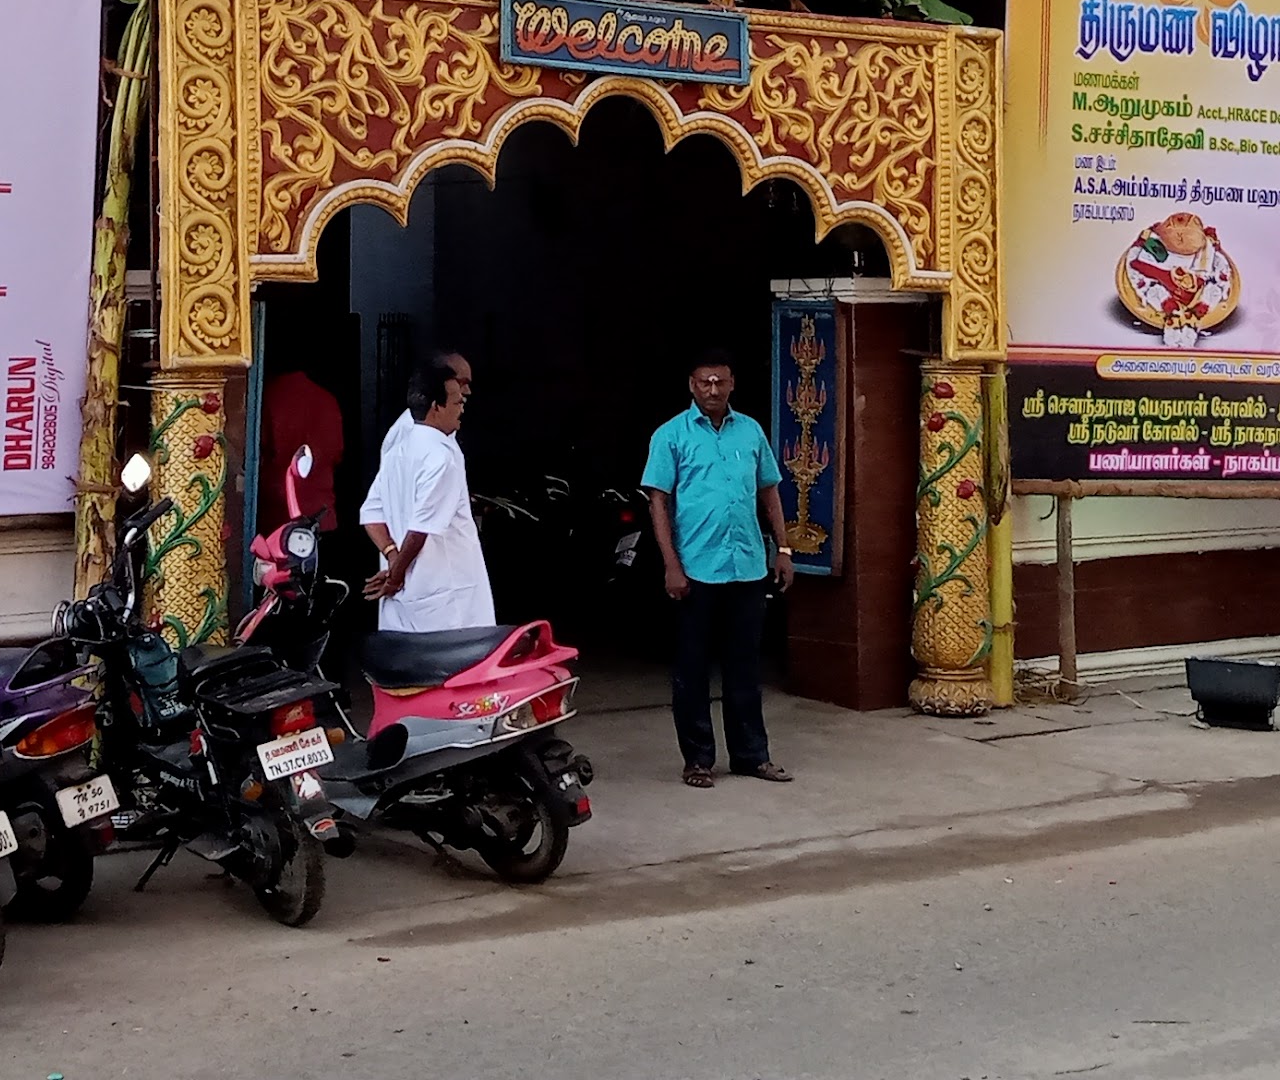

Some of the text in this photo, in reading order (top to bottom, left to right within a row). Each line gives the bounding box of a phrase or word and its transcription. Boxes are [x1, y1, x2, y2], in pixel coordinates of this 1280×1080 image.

[1074, 69, 1139, 90] மணமக்கள்
[1072, 91, 1193, 121] M.ஆறுமுகம்
[1190, 181, 1243, 204] திருமண
[3, 357, 37, 471] DHARUN
[1138, 393, 1209, 420] பெருமாள்
[1211, 395, 1267, 419] கோவில்
[1142, 418, 1199, 442] கோவில்
[1089, 447, 1211, 471] பணியாளர்கள்
